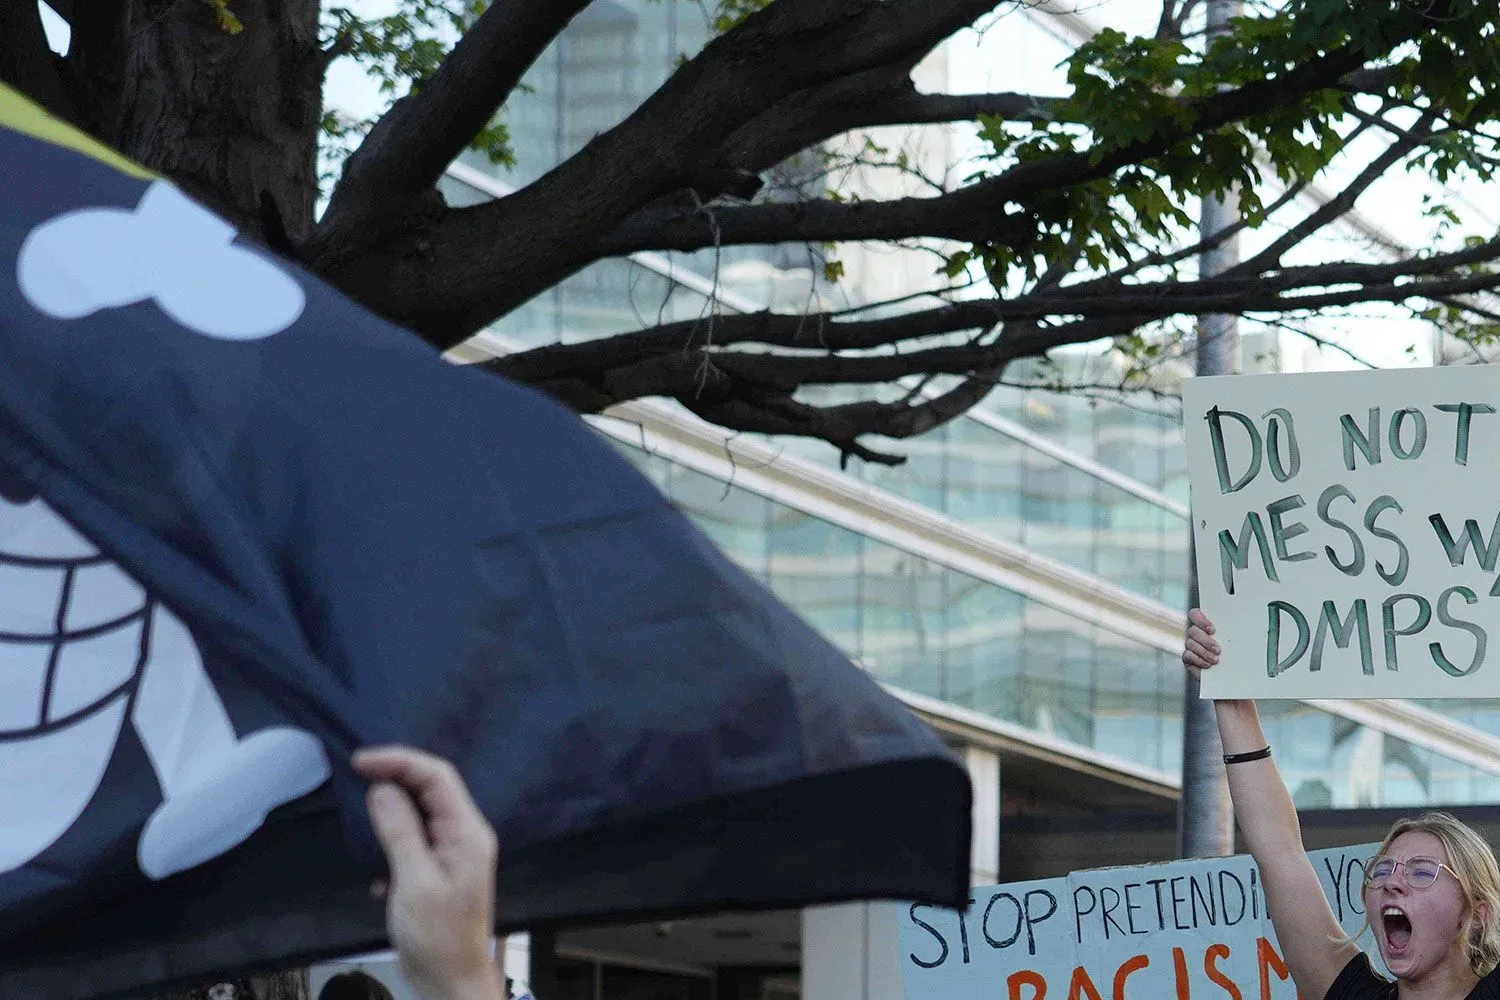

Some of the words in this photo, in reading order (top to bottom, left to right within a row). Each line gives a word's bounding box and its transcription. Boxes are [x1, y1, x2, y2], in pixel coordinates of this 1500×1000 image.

[1204, 405, 1300, 494] DO
[1340, 402, 1497, 470] NOT
[1219, 485, 1411, 594] MESS
[1268, 586, 1487, 677] DMPS
[910, 889, 1057, 968] STOP
[1076, 869, 1271, 943] PRETENDI
[1324, 854, 1365, 922] YO
